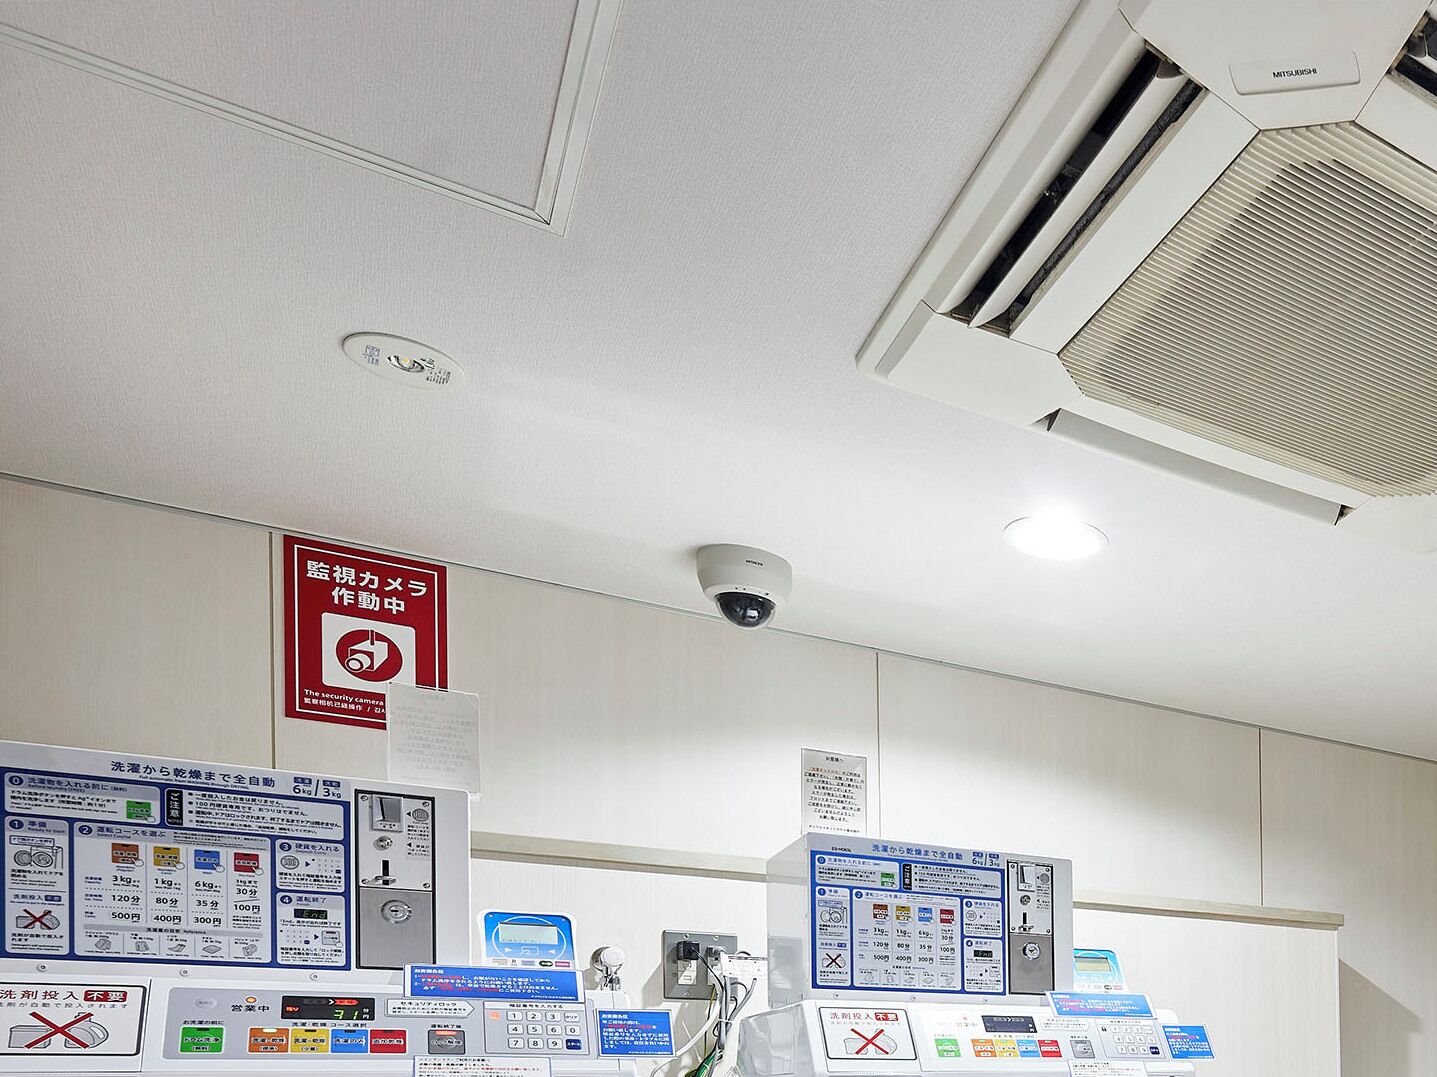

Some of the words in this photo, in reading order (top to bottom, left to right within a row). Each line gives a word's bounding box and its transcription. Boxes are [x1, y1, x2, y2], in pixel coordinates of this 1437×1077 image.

[1272, 67, 1318, 79] MITSUBISHI
[306, 560, 428, 597] 監視カメラ
[331, 587, 405, 614] 作動中
[304, 689, 320, 697] The
[321, 691, 353, 702] security
[355, 696, 384, 706] camera
[110, 760, 276, 788] 洗濯から乾燥まで全自動
[292, 784, 312, 796] 6kg
[322, 787, 342, 798] 3kg
[872, 843, 963, 861] 洗濯から乾燥まで全自動
[236, 887, 257, 896] 30分
[112, 894, 140, 903] 120分
[156, 897, 179, 906] 80分
[196, 900, 219, 909] 35分
[234, 904, 261, 912] 100円
[111, 912, 141, 921] 500円
[154, 915, 182, 924] 400円
[194, 916, 222, 926] 300円
[873, 954, 889, 962] 500円
[896, 955, 912, 963] 400円
[918, 956, 934, 964] 300円
[0, 989, 79, 1001] 洗剤投入
[86, 991, 125, 1001] 不要
[830, 1012, 873, 1020] 洗剤投入
